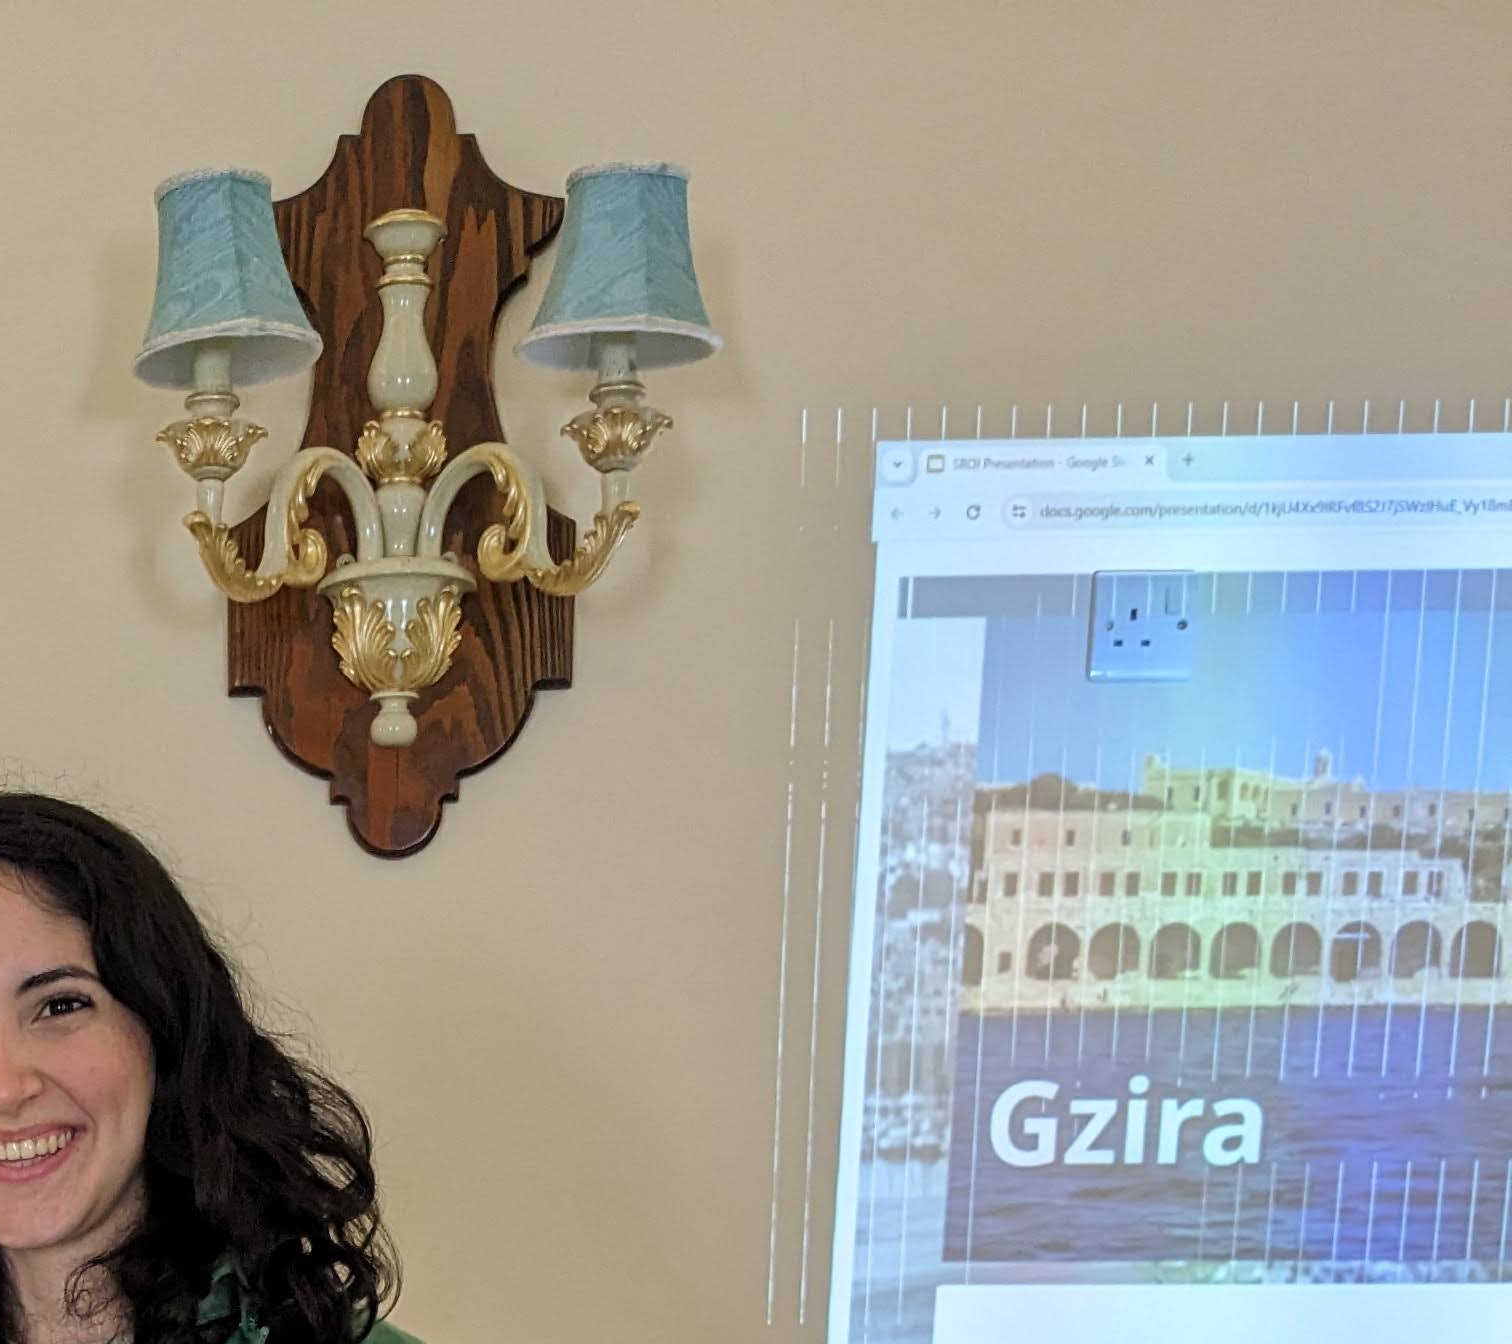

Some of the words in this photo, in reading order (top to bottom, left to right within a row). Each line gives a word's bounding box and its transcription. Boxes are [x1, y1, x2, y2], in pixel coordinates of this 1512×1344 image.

[983, 457, 1055, 470] Presentation
[1066, 457, 1108, 471] Google
[990, 1074, 1264, 1168] Gzira
